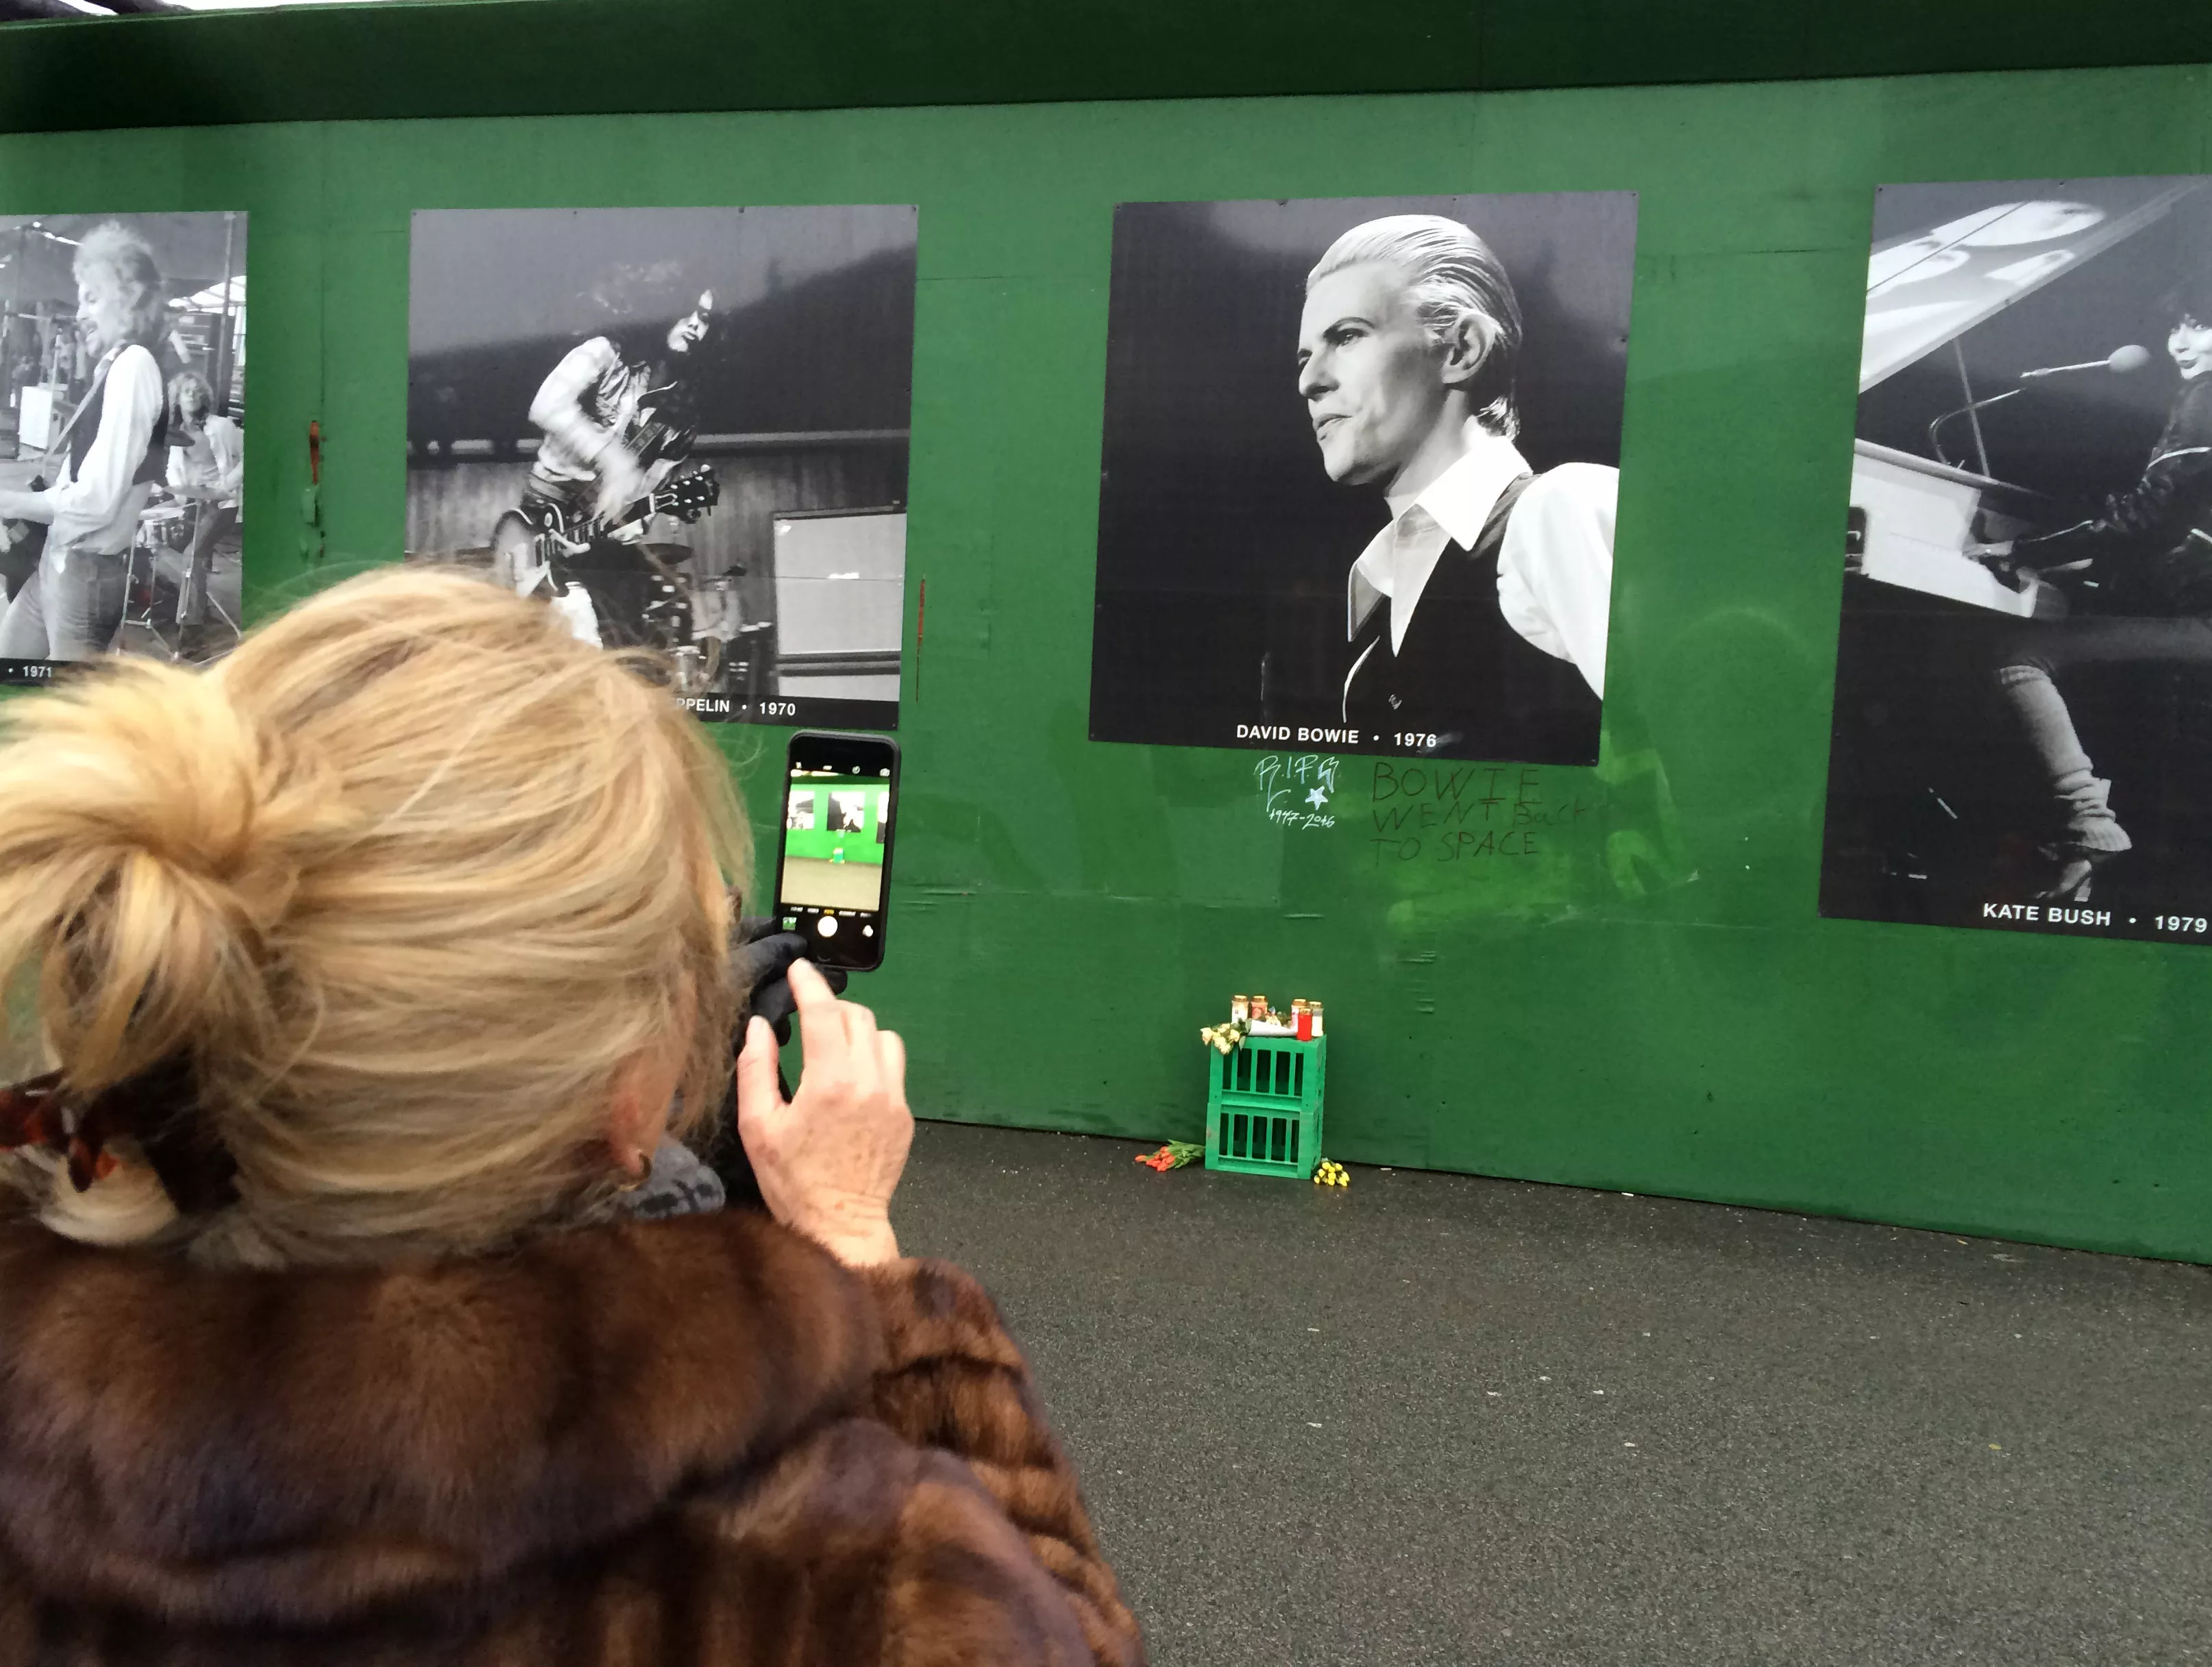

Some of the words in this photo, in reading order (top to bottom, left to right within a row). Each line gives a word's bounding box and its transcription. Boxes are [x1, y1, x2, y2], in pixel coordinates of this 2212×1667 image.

[22, 665, 52, 678] 1971
[676, 697, 730, 713] PPELIN
[759, 702, 796, 716] 1970
[1236, 724, 1291, 741] DAVID
[1298, 727, 1360, 744] BOWIE
[1394, 732, 1437, 748] 1976
[1373, 761, 1543, 805] BOWIE
[1268, 808, 1336, 830] 1947-2016
[1373, 800, 1499, 833] WENT
[1370, 837, 1422, 867] TO
[1437, 830, 1539, 862] SPACE
[1982, 902, 2040, 921] KATE
[2048, 906, 2111, 926] BUSH
[2155, 915, 2208, 934] 1979
